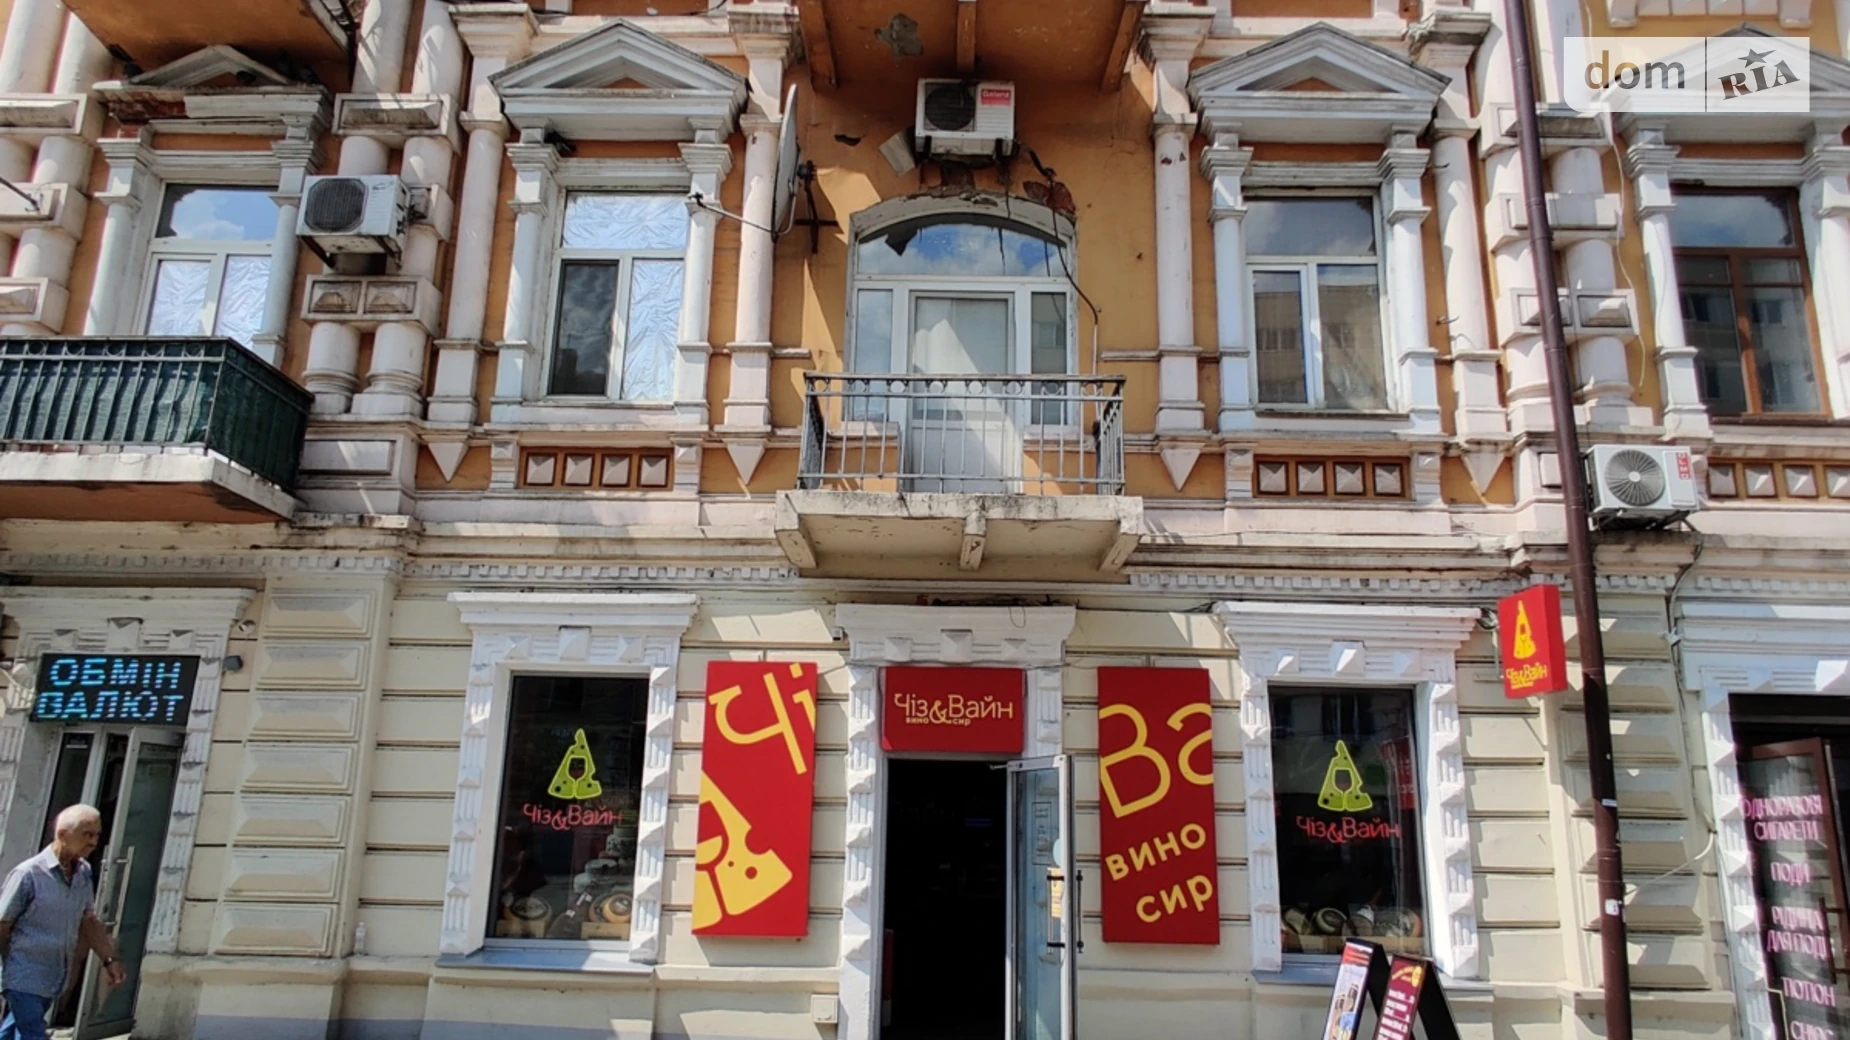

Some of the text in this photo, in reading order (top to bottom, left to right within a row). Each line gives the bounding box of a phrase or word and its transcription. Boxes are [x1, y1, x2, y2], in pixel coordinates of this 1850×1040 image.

[50, 658, 181, 689] ОБМІН
[37, 691, 184, 721] ВАЛЮТ
[893, 693, 1014, 724] Чіз&Вайн
[522, 803, 623, 830] Чіз&Вайн
[1296, 816, 1402, 843] Чіз&Вайн
[1754, 820, 1819, 841] СИГАРЕТИ
[1105, 823, 1206, 881] вино
[1770, 862, 1811, 886] ПОДИ
[1136, 875, 1213, 923] сир
